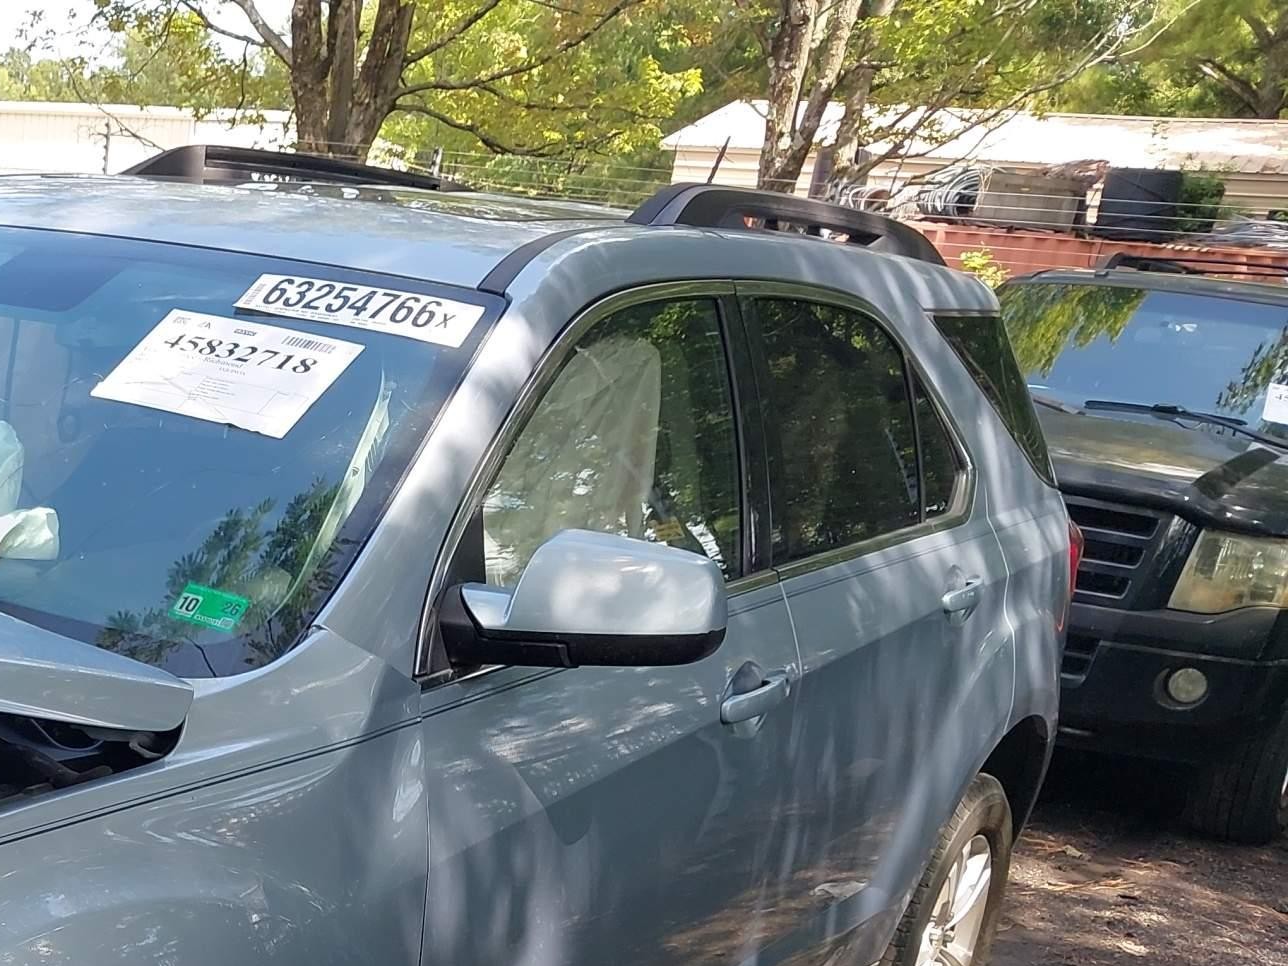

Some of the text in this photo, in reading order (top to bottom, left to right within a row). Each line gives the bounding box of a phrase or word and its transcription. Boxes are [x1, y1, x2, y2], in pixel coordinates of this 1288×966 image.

[163, 333, 319, 375] 45832718
[178, 595, 242, 616] 10 26
